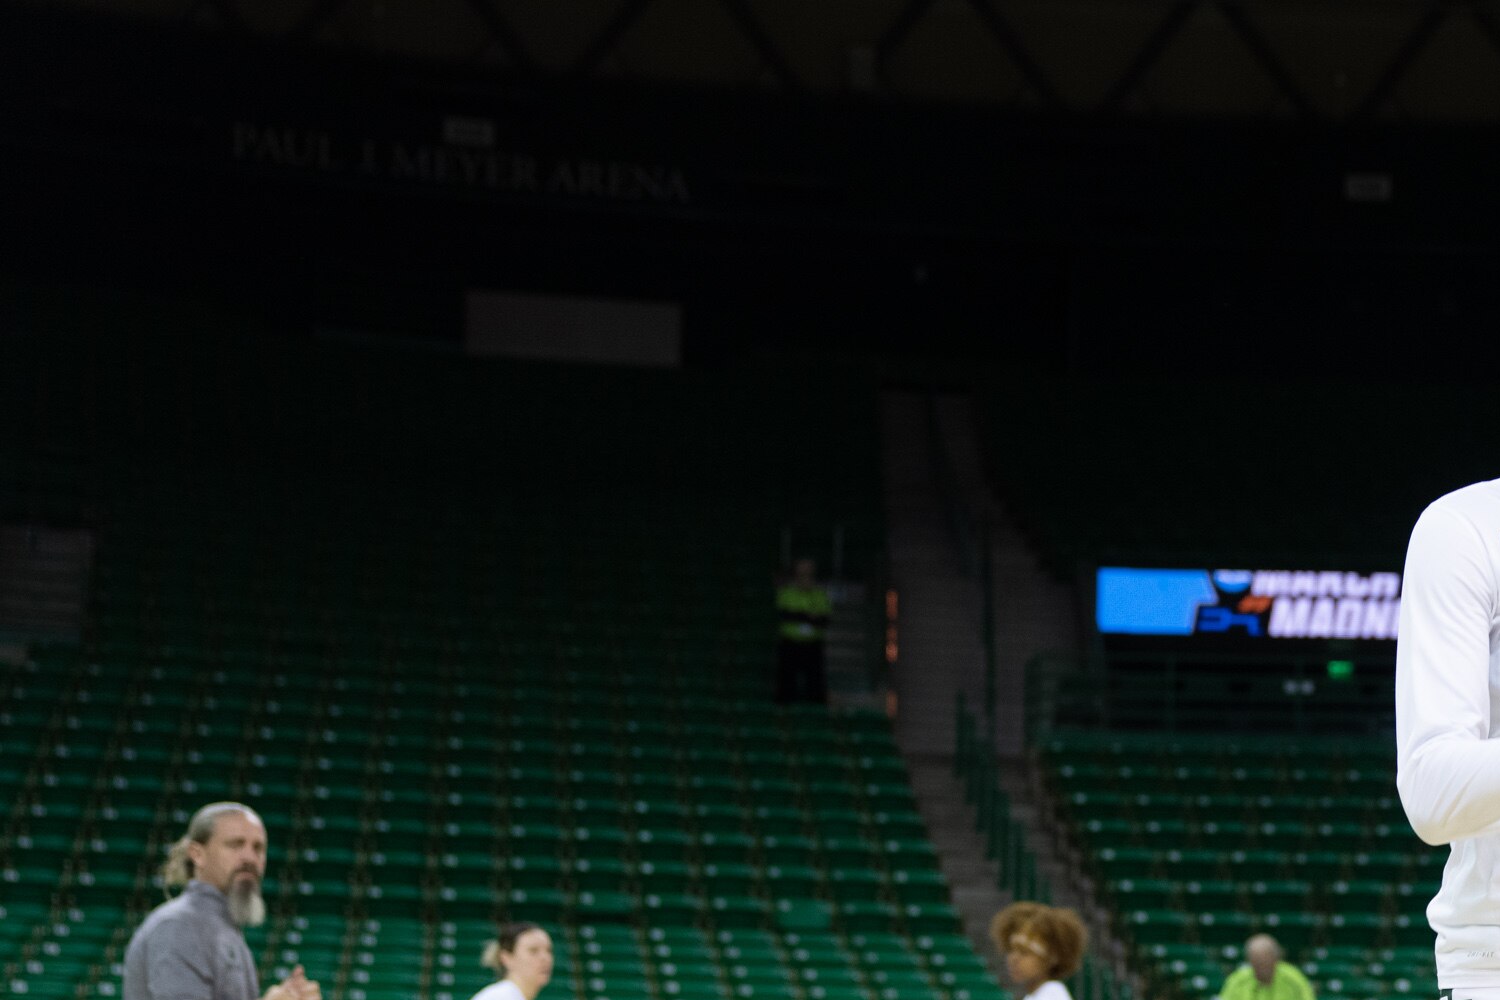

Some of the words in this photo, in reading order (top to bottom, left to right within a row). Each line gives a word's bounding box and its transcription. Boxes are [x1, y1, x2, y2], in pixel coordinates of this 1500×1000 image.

[231, 119, 344, 172] PAUL
[390, 142, 539, 192] MEYER
[545, 159, 693, 204] ARENA
